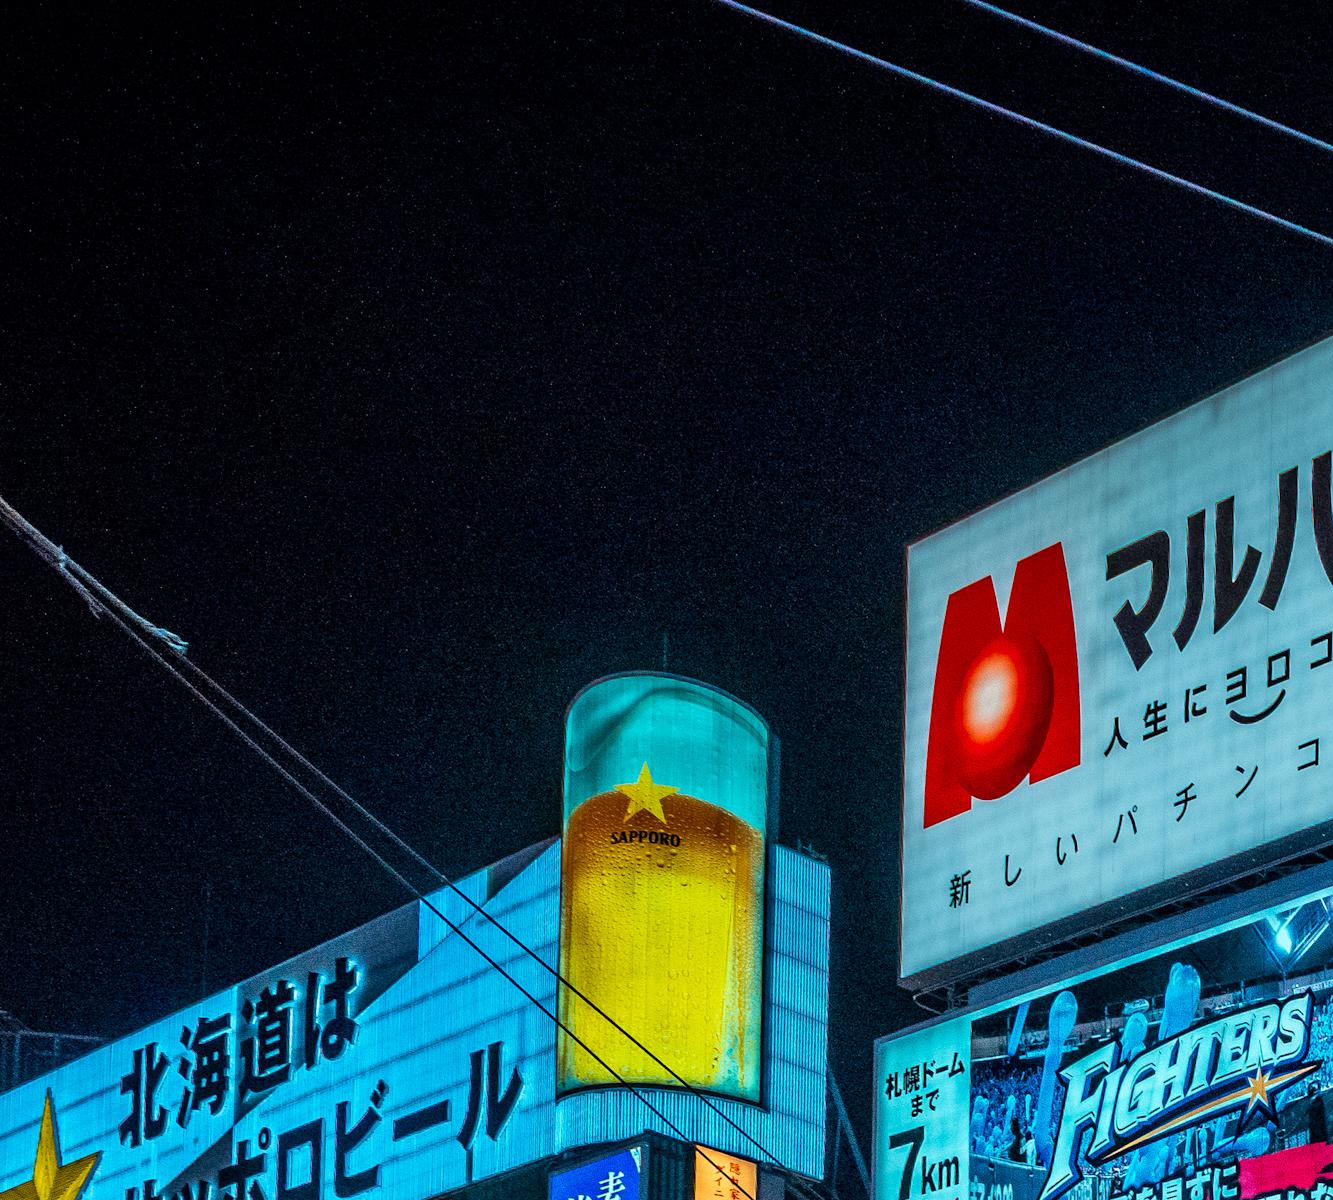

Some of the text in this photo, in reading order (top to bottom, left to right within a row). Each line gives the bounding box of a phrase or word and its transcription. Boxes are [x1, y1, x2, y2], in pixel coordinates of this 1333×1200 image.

[117, 957, 362, 1149] 北海道は
[884, 1053, 965, 1101] 札幌ドーム
[910, 1092, 939, 1118] まで
